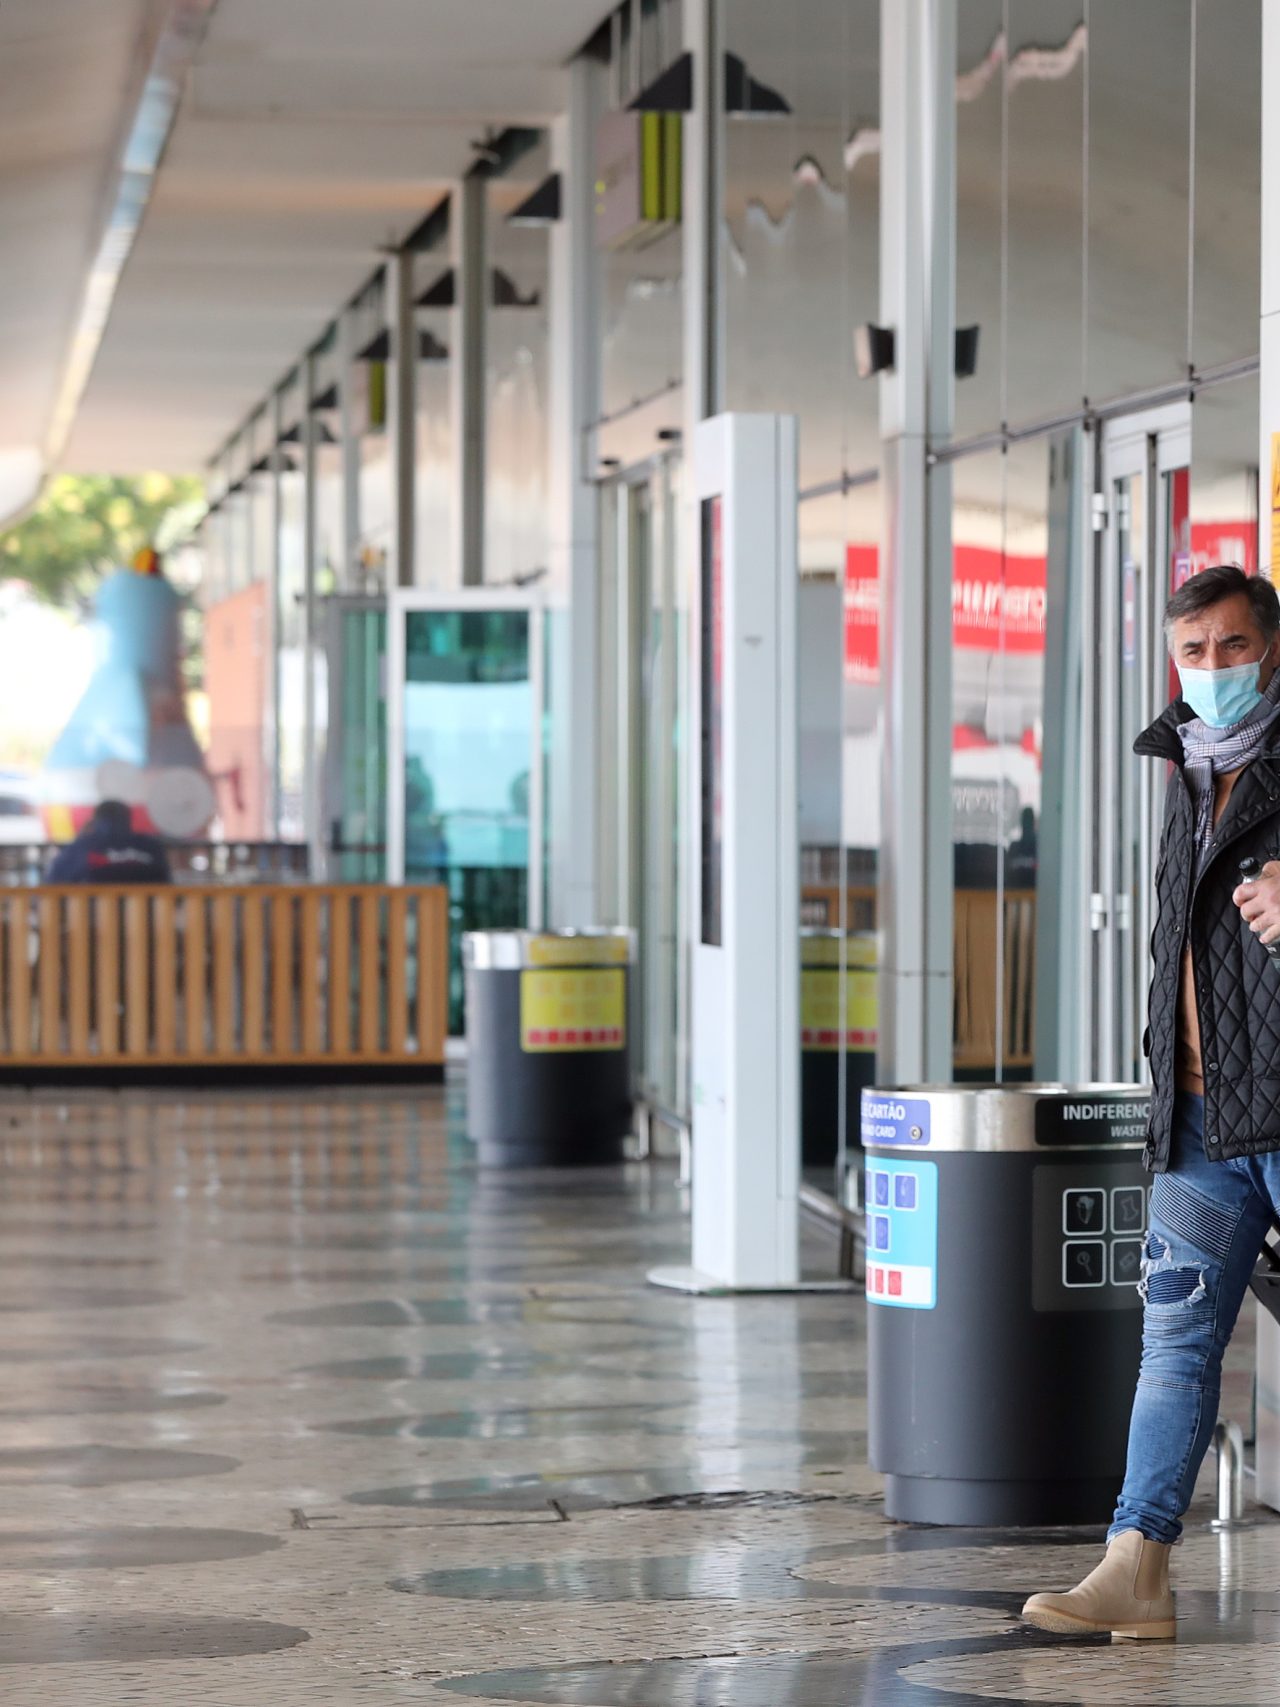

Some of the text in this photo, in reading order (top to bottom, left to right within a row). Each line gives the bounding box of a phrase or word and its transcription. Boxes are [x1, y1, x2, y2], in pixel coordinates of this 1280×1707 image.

[868, 1101, 906, 1121] CARTÃO
[1063, 1103, 1151, 1120] INDIFERENC
[1111, 1124, 1146, 1137] WASTE
